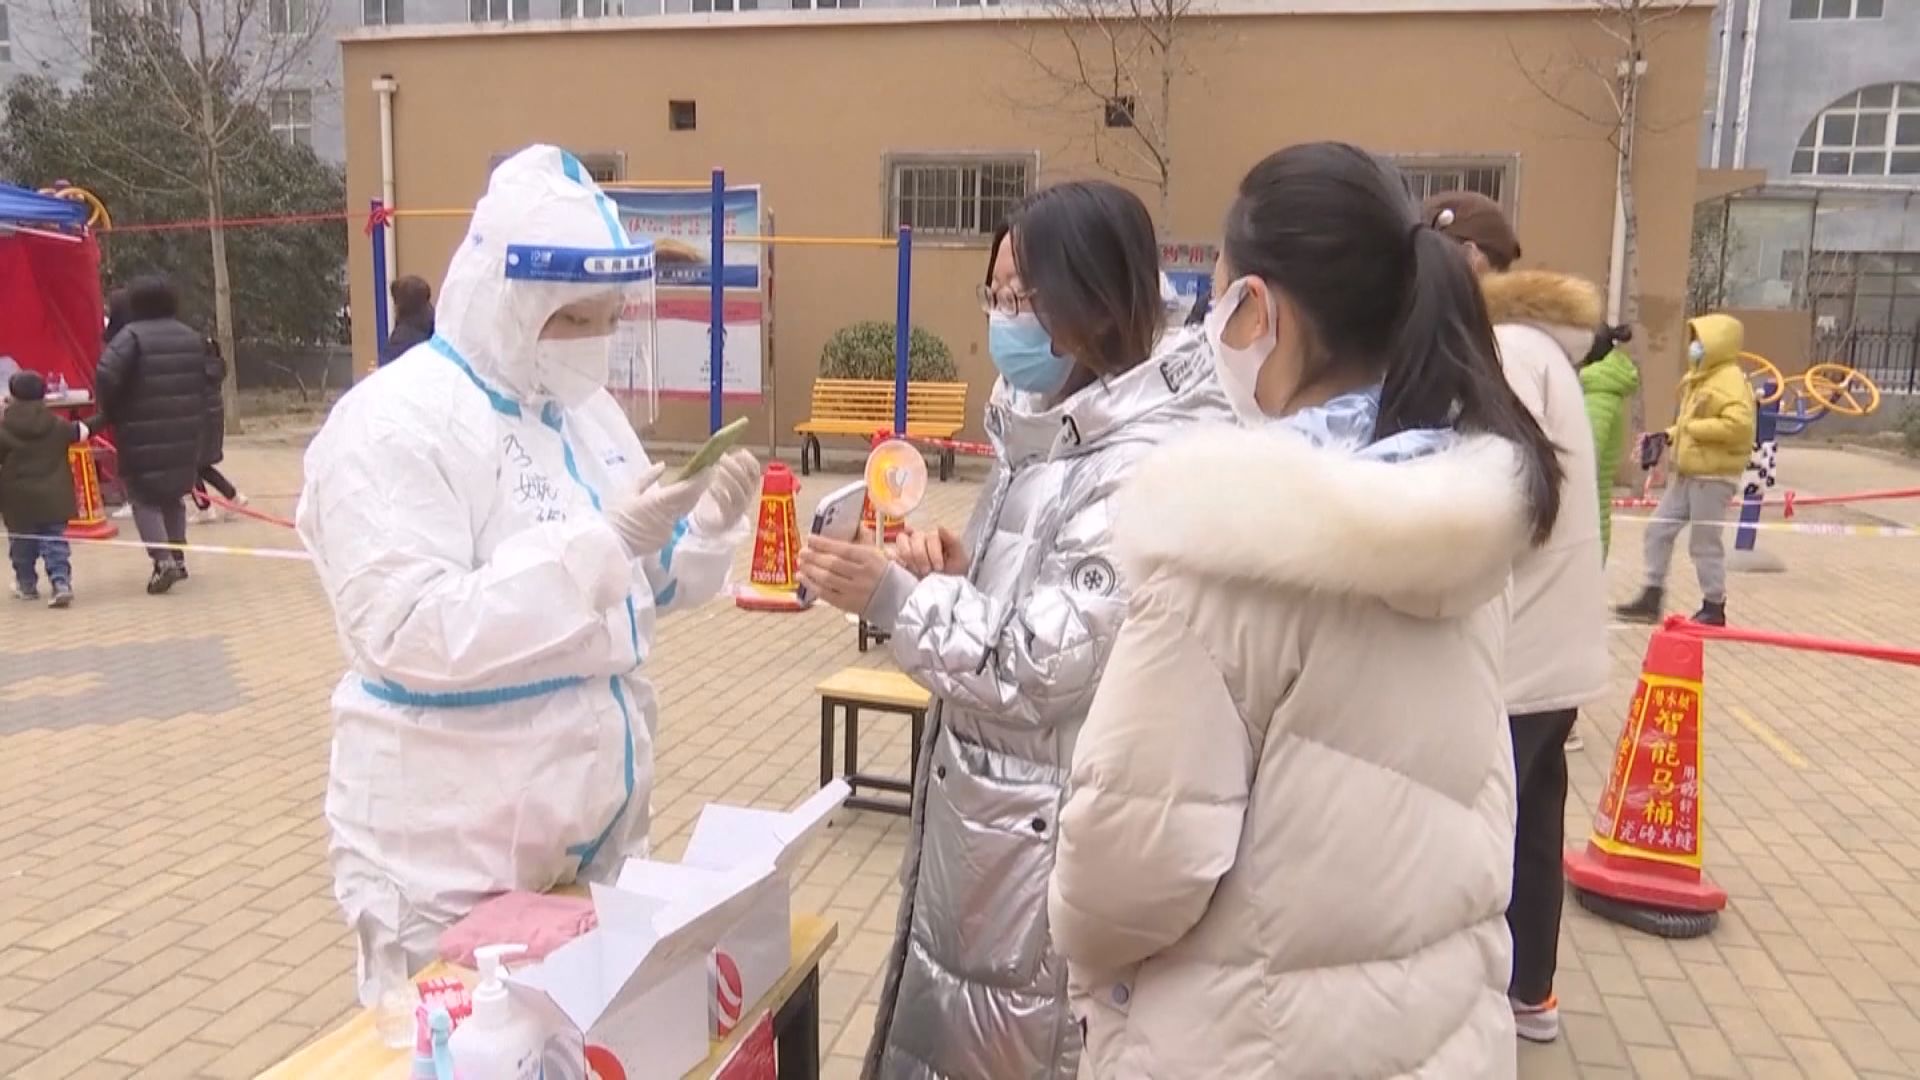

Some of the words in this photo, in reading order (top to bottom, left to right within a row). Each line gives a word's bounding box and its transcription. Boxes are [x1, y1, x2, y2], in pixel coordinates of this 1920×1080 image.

[1645, 711, 1683, 826] 智能马桶
[1621, 820, 1694, 851] 瓷砖美缝
